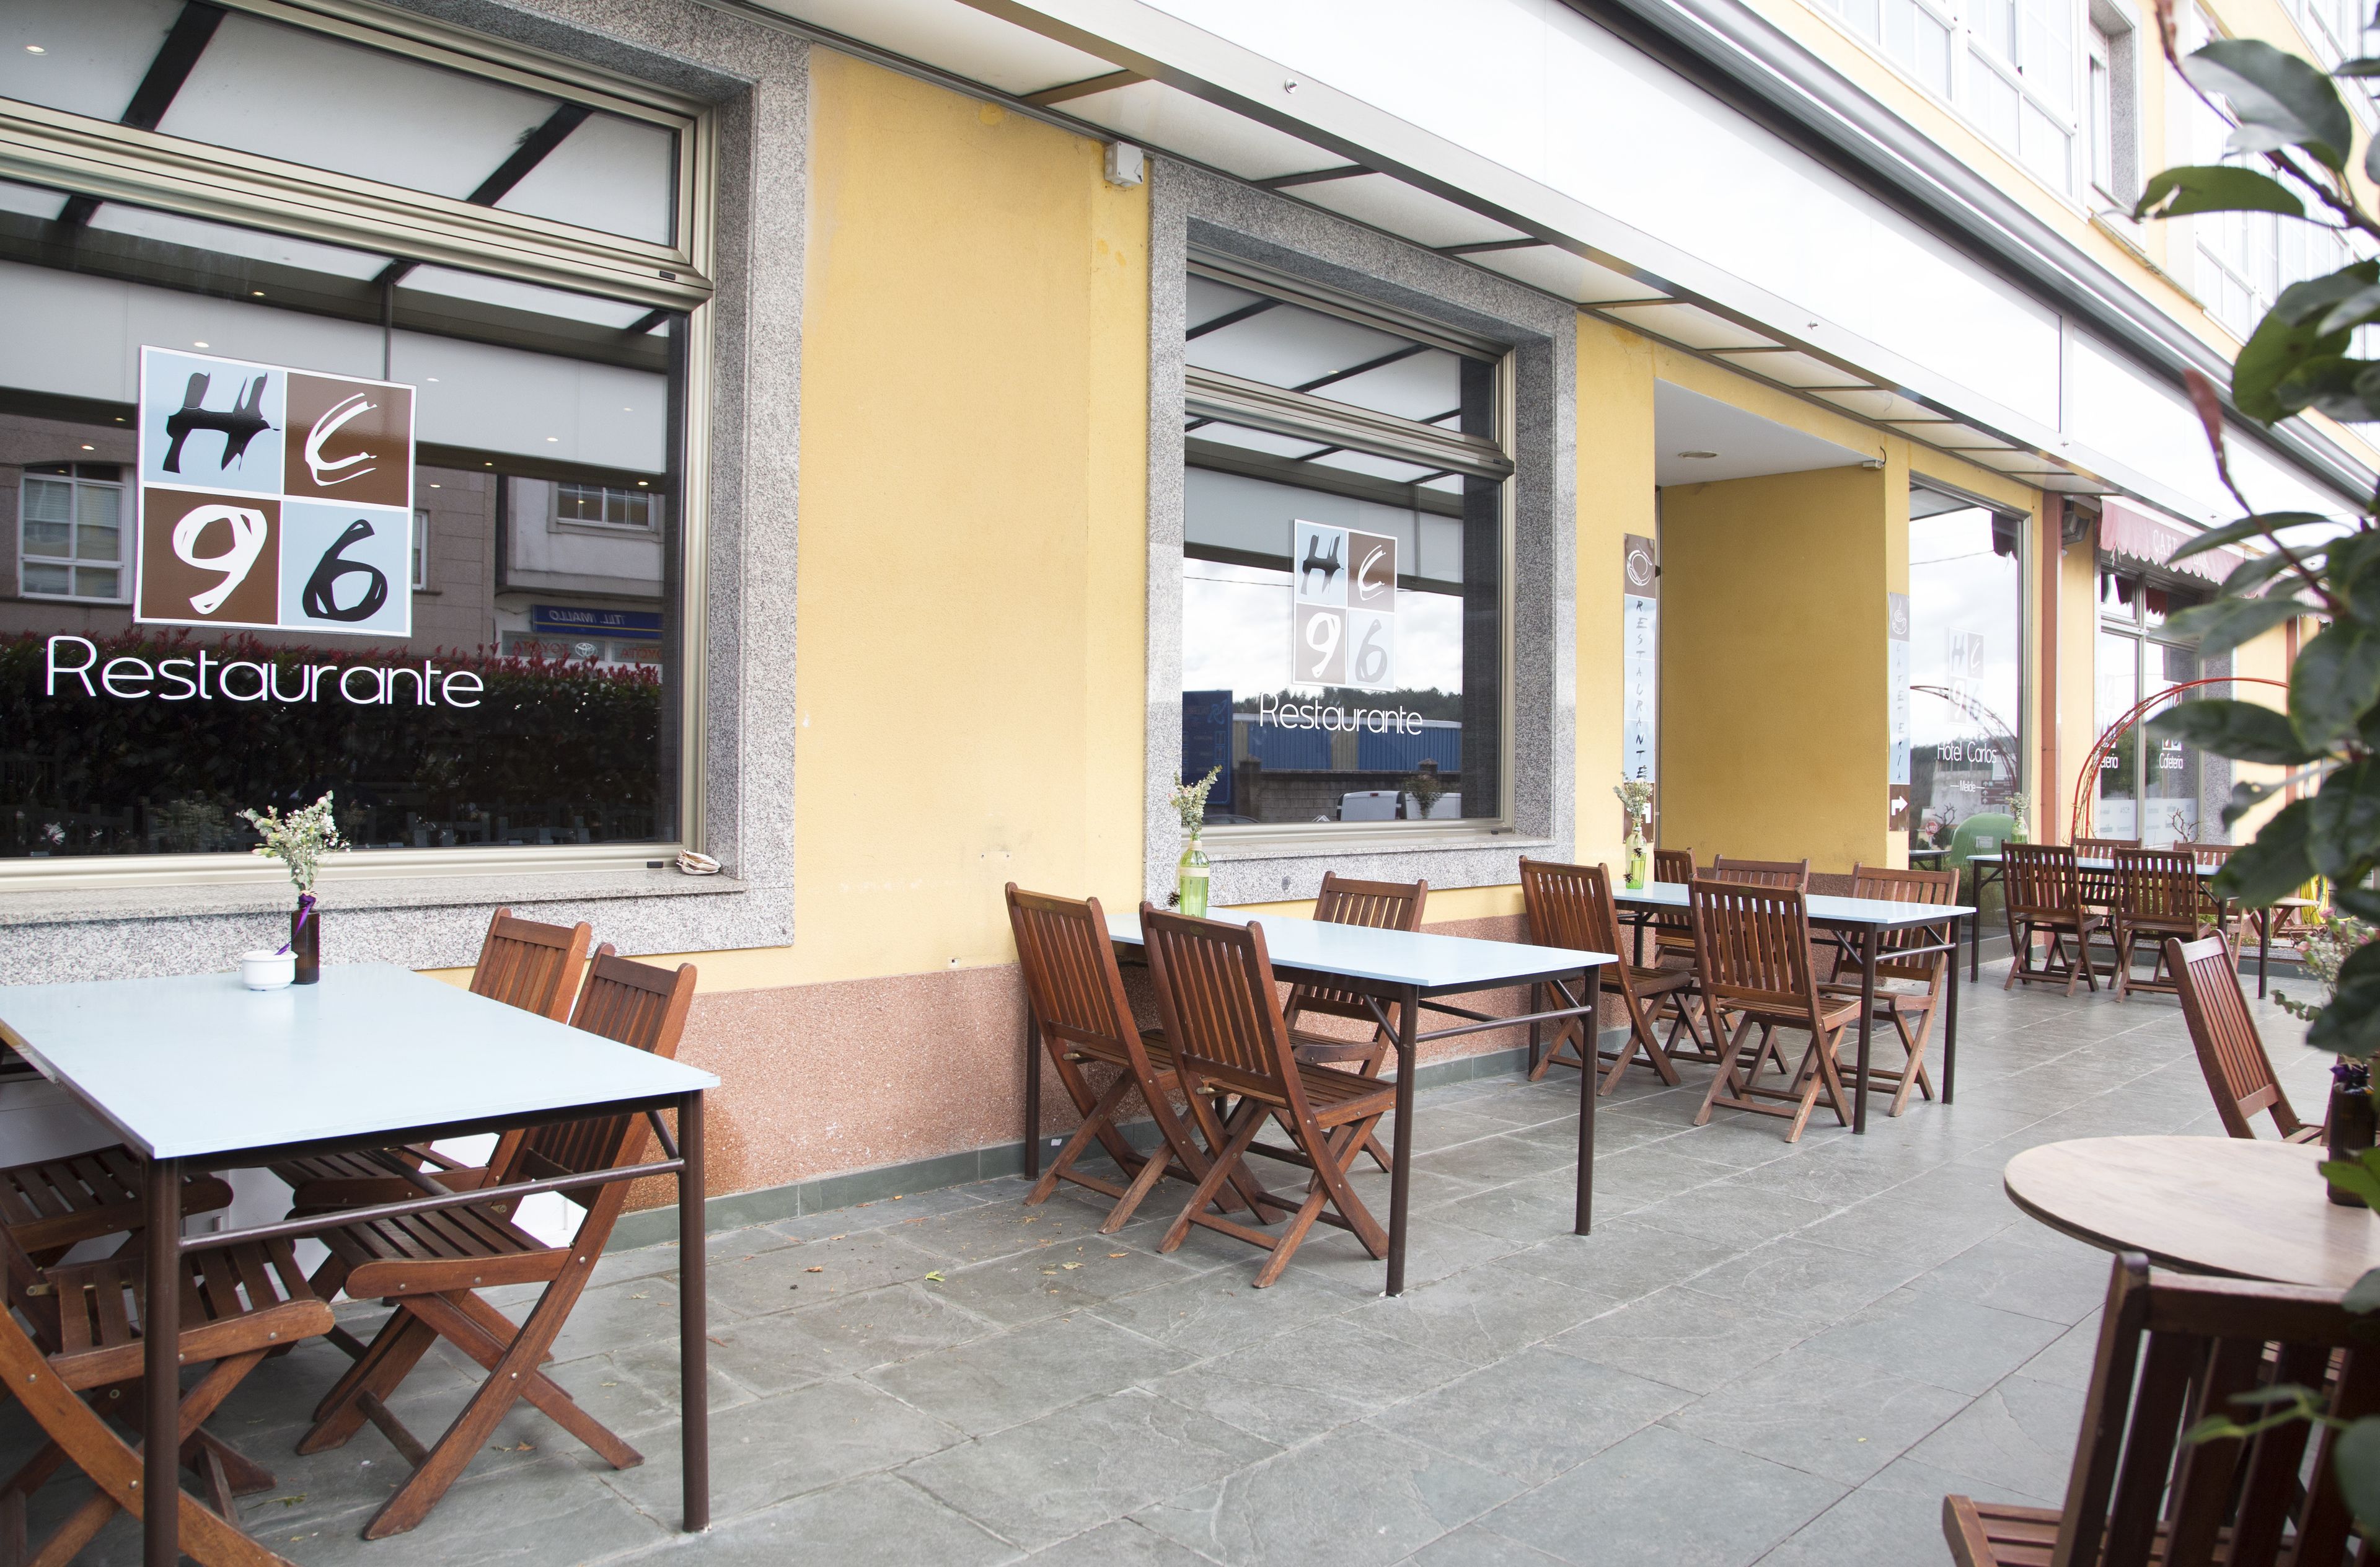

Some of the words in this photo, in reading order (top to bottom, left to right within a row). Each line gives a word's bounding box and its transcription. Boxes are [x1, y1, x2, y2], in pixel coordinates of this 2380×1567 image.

[46, 635, 484, 708] Restaurante
[1636, 600, 1647, 779] RESTAURANTE
[1259, 691, 1424, 736] Restaurante
[1937, 741, 1962, 761] Hotel
[1967, 741, 1997, 764] Carlos
[2159, 753, 2184, 769] Cafeteria
